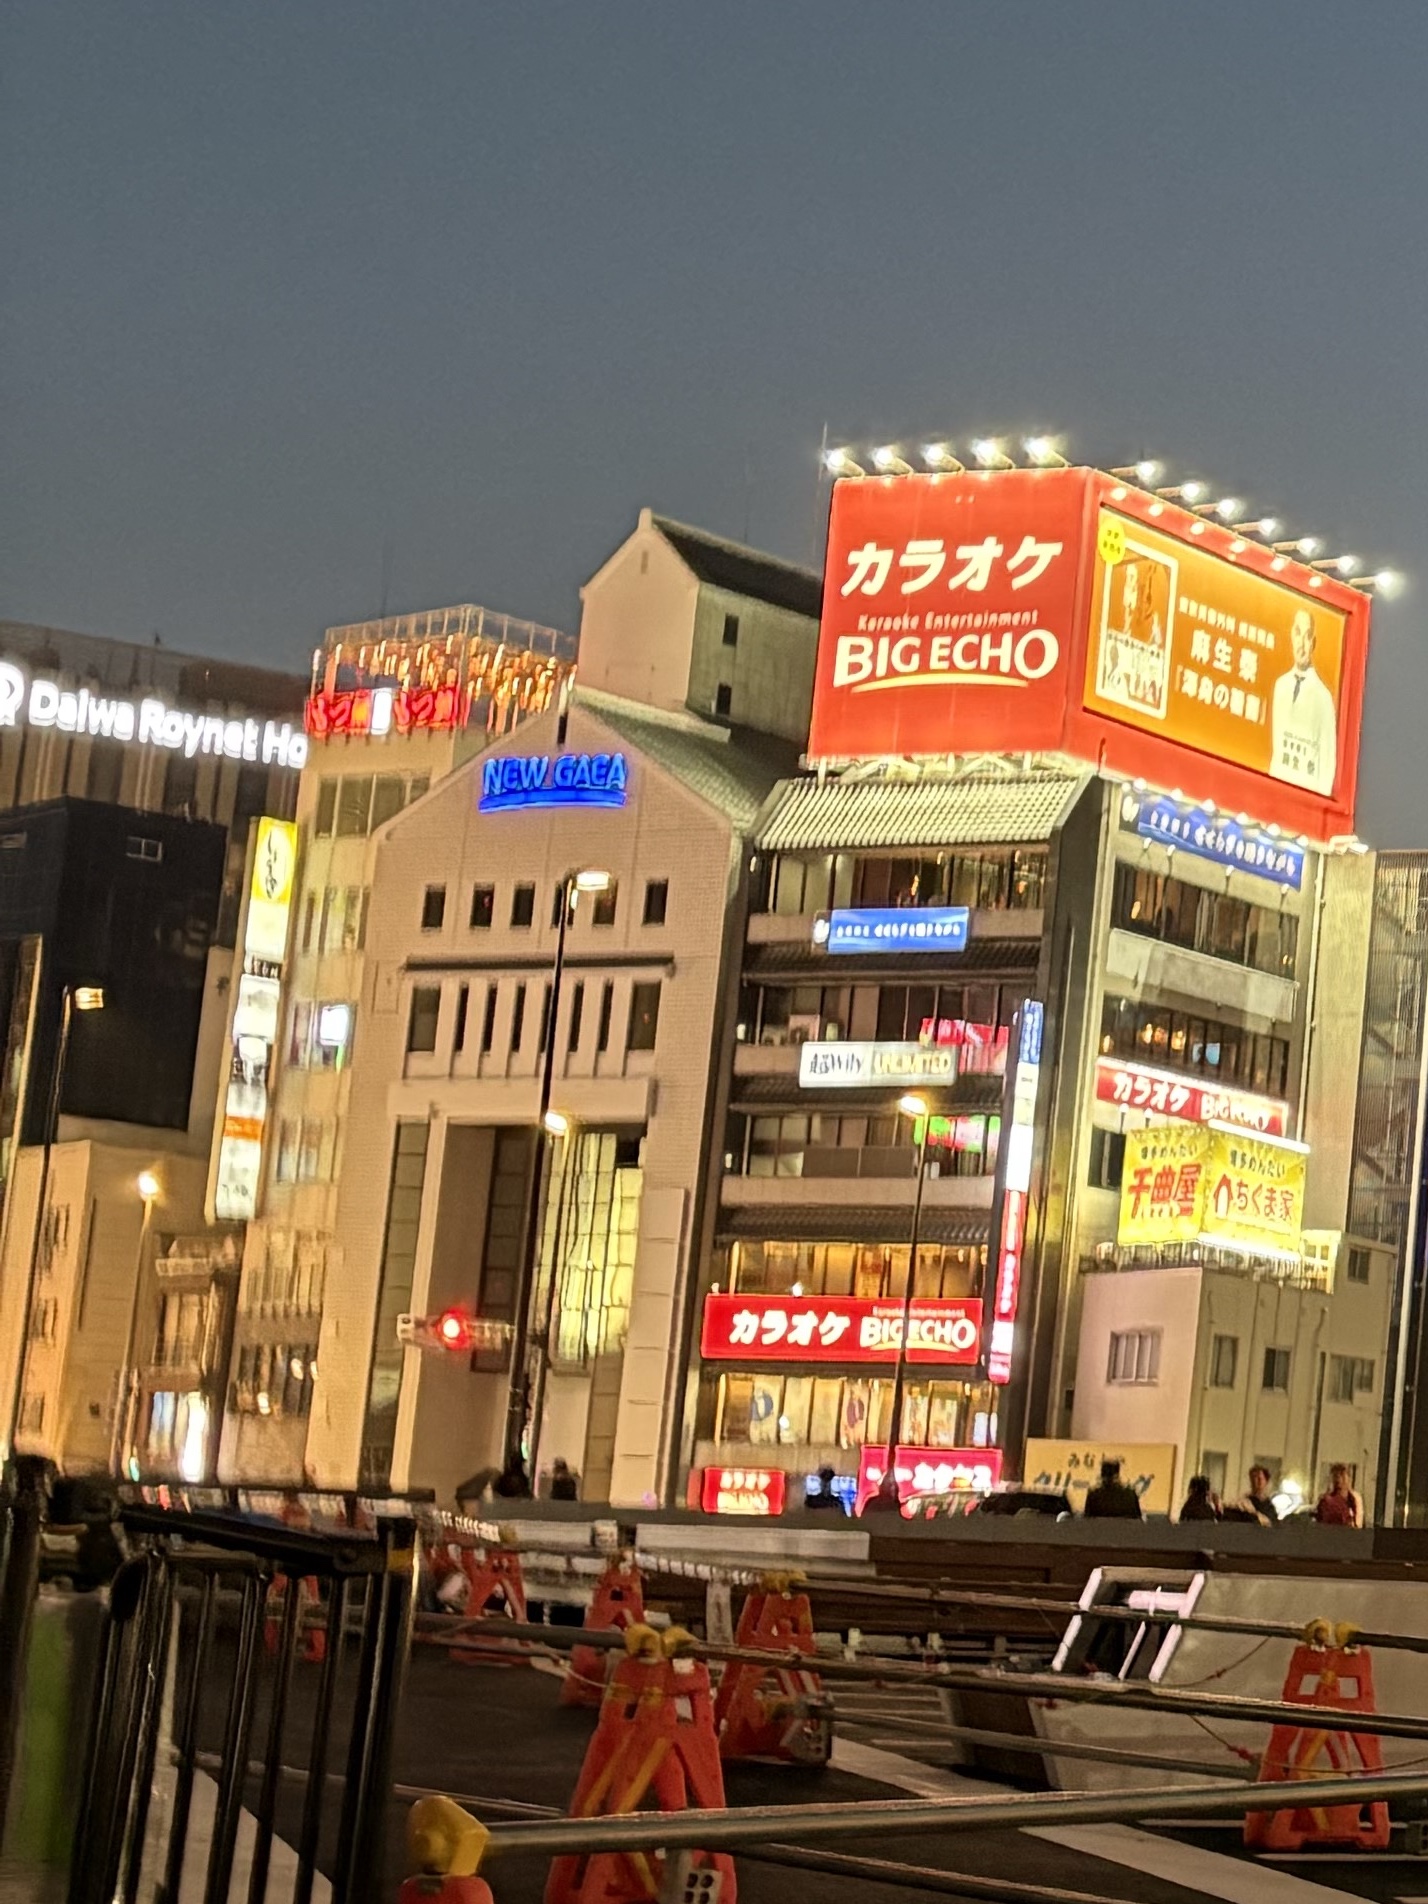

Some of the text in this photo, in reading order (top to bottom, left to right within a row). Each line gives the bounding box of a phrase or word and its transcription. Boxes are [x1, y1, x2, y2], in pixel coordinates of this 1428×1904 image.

[841, 535, 1063, 597] カラオケ
[833, 628, 1059, 688] BIG ECHO
[29, 679, 135, 741] Daiwa
[139, 697, 260, 760] Roynet
[484, 752, 626, 794] NEW GAEA
[1114, 1071, 1190, 1112] カラオケ
[1236, 1179, 1295, 1222] ちくま家
[729, 1309, 976, 1349] カラオケ BIG ECHO
